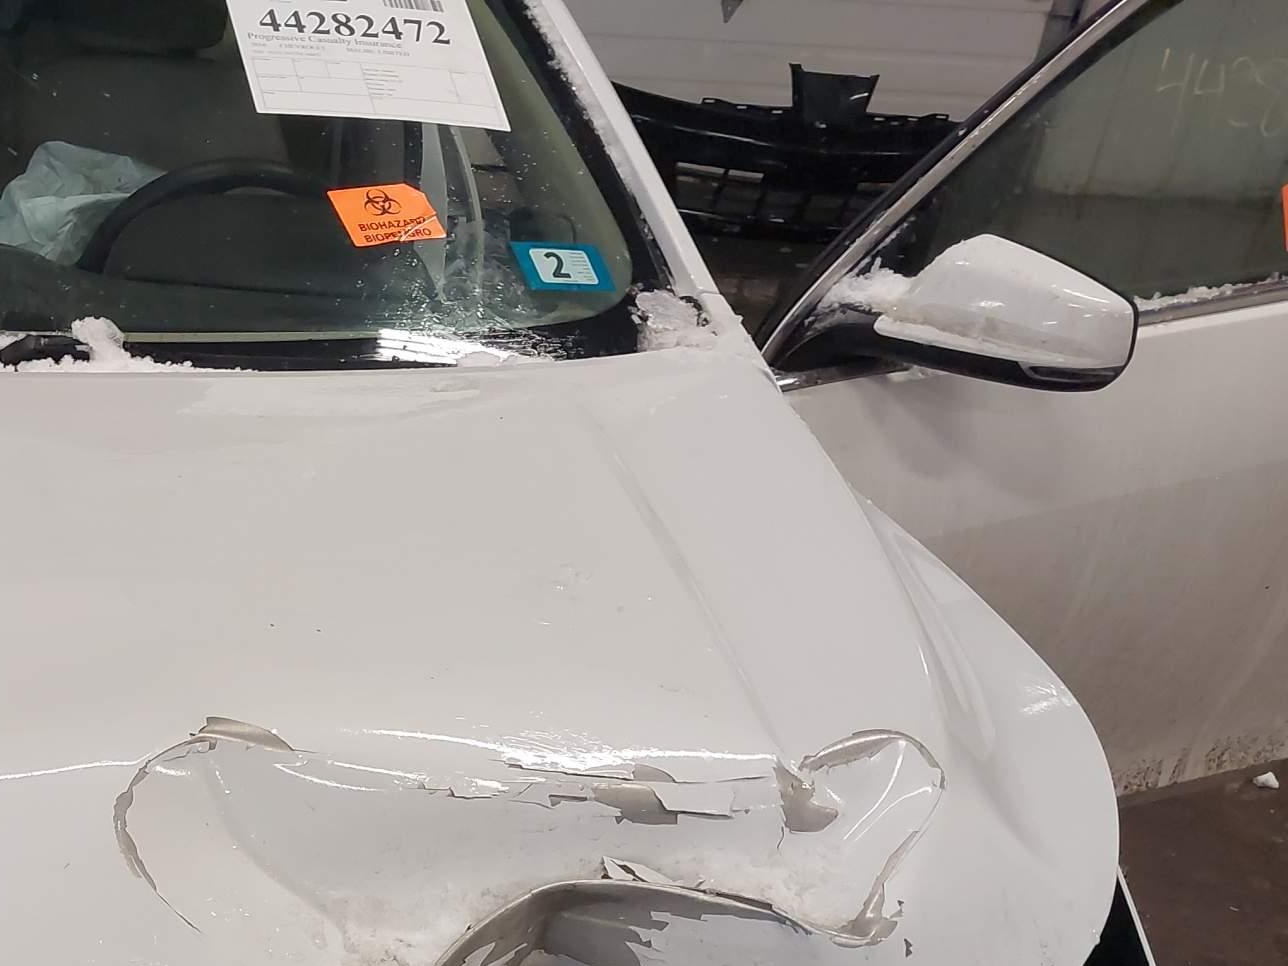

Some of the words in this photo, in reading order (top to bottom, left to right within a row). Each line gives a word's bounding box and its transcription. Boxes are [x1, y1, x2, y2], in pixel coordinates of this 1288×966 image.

[247, 32, 306, 42] Progressive
[354, 39, 403, 49] Insurance
[259, 8, 451, 45] 44282472
[543, 252, 572, 280] 2
